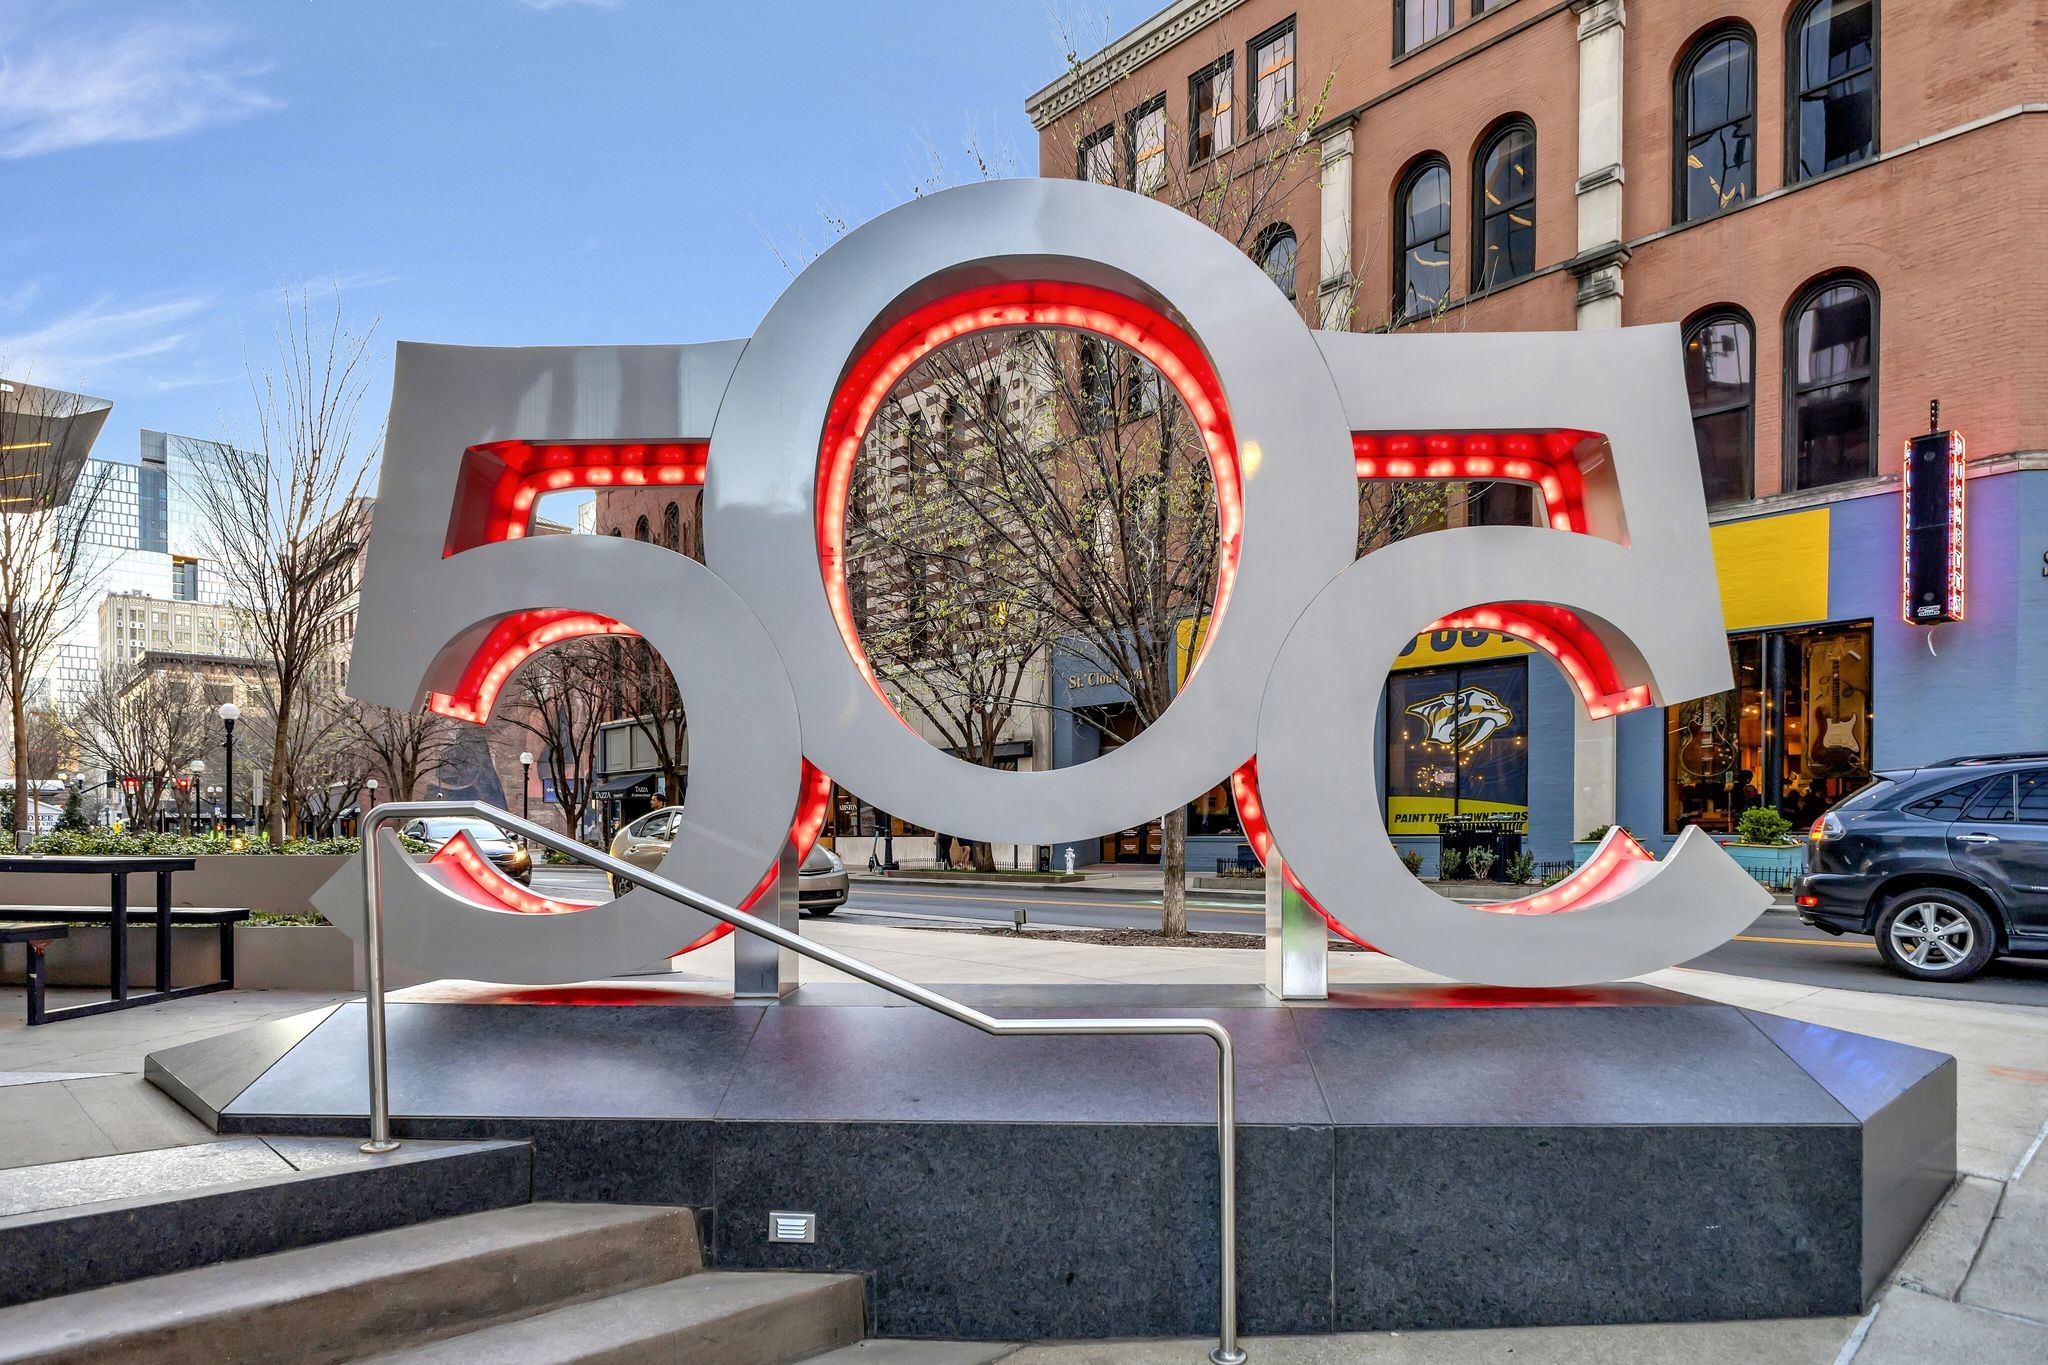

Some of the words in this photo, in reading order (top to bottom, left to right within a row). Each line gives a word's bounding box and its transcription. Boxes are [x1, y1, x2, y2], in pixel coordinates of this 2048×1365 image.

[1069, 675, 1085, 689] St.
[594, 791, 612, 799] TAZZA
[1394, 813, 1427, 823] PAINT
